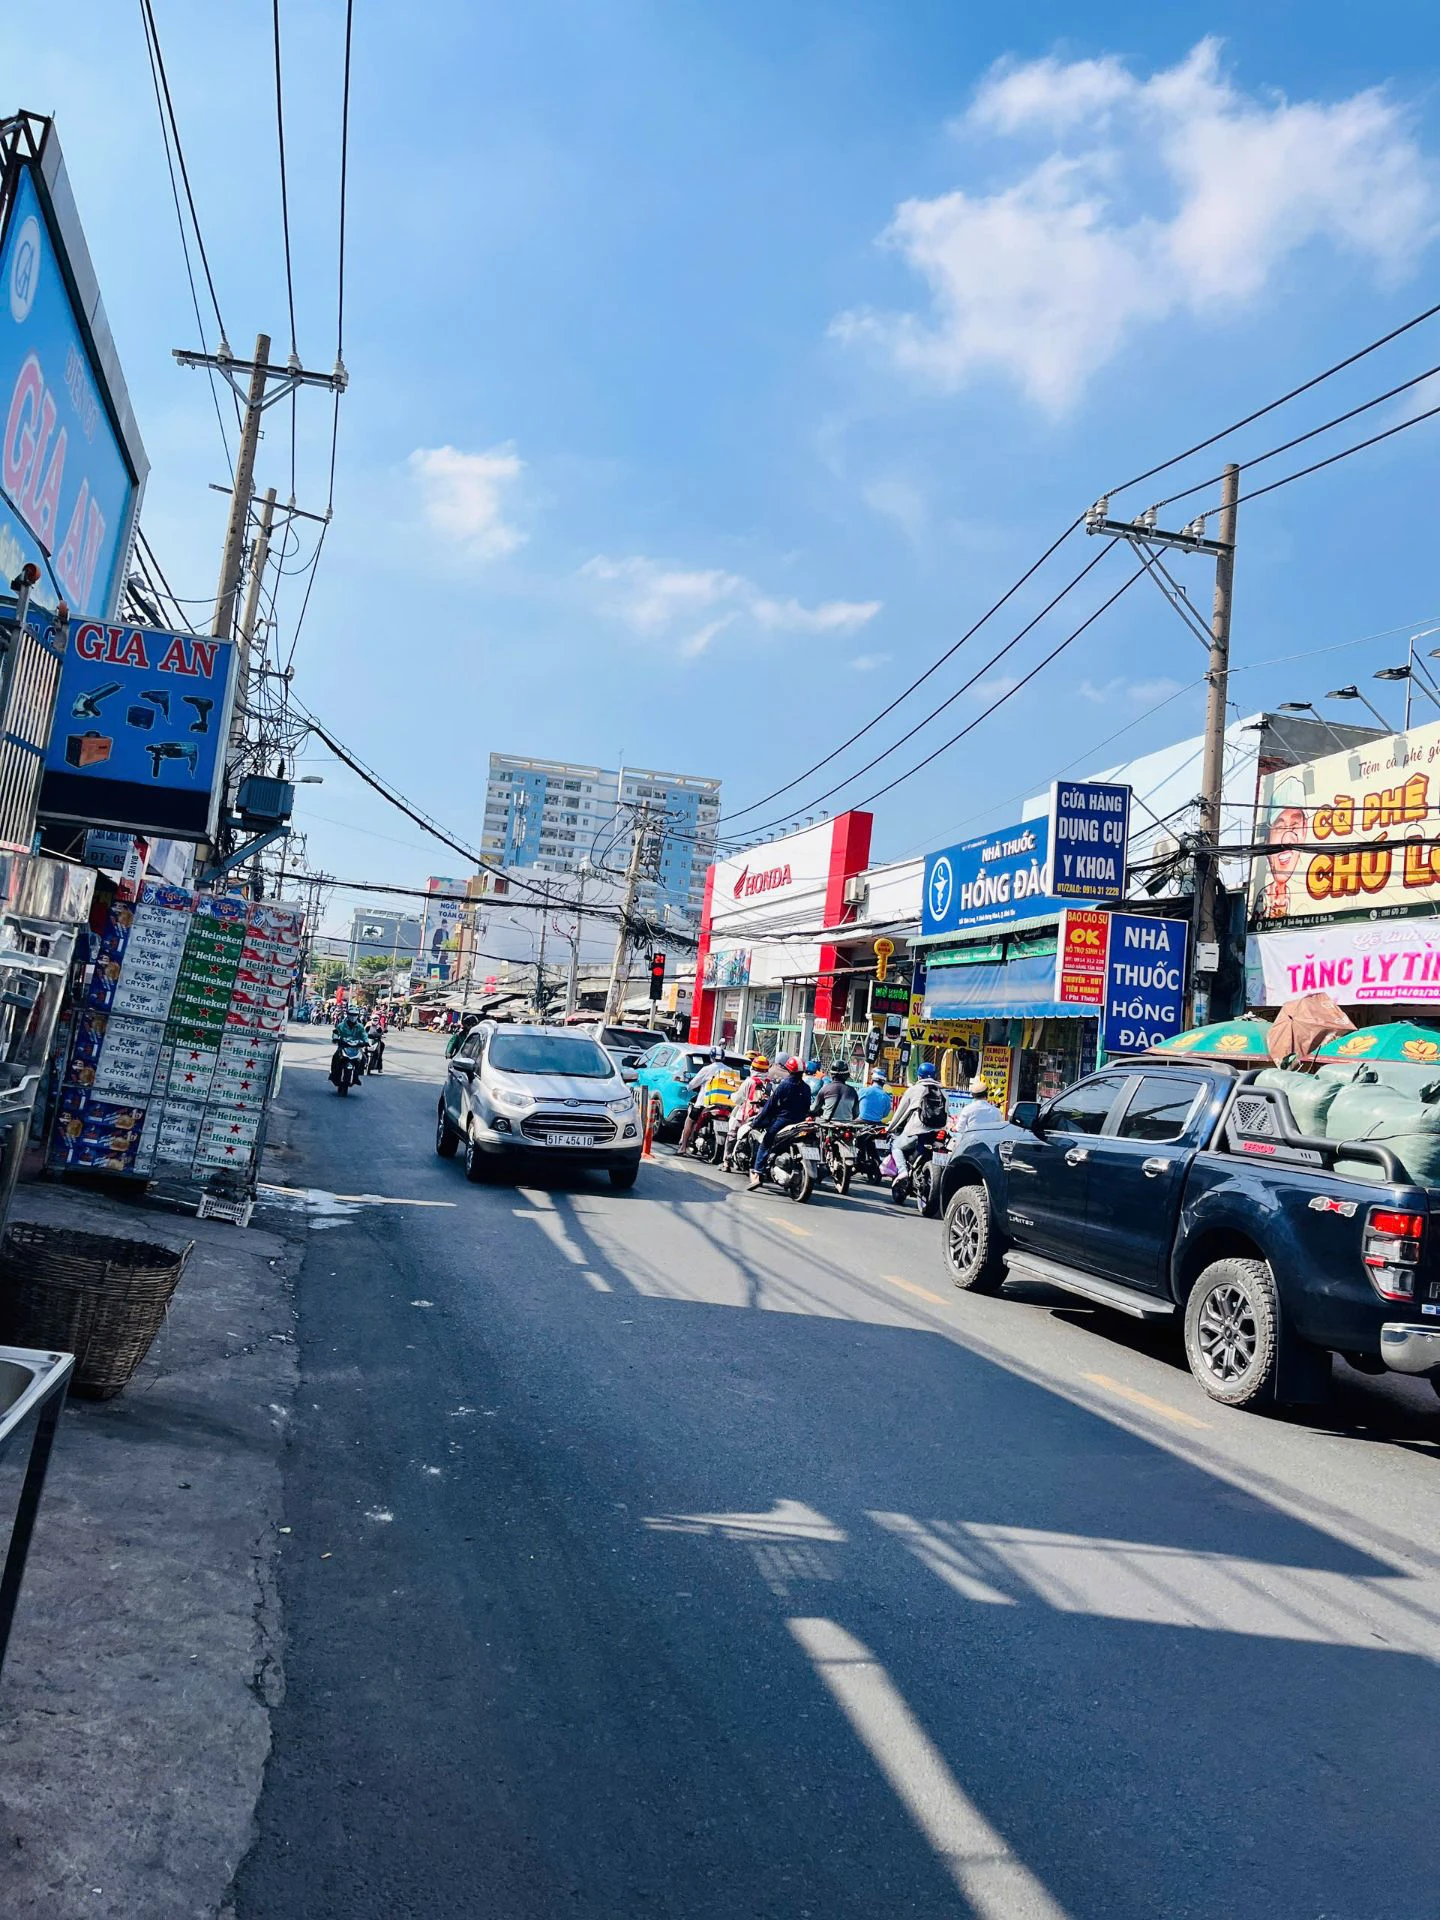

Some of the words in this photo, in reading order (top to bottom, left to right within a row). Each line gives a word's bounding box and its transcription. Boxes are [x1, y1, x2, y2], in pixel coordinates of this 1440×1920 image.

[3, 353, 67, 554] GIA
[56, 477, 106, 614] AN
[75, 623, 150, 669] GIA
[157, 637, 220, 679] AN
[1358, 761, 1380, 779] Tiệm
[1402, 746, 1423, 769] phê
[1061, 787, 1086, 810] CỬA
[1089, 791, 1122, 812] HÀNG
[1362, 772, 1430, 831] PHÊ
[1058, 816, 1099, 845] DỤNG
[1103, 820, 1123, 849] CỤ
[982, 840, 1002, 862] NHÀ
[1002, 829, 1037, 857] THUỐC
[1063, 854, 1073, 877] Y
[1076, 856, 1116, 880] KHOA
[1306, 831, 1392, 901] CHÚ
[745, 864, 792, 896] HONDA
[961, 868, 1011, 911] HỒNG
[142, 913, 176, 925] CRYSTAL
[1067, 911, 1082, 922] BAO
[1082, 912, 1097, 923] CAO
[1097, 914, 1108, 924] SU
[136, 935, 170, 947] CRYSTAL
[201, 929, 242, 945] Heineken
[1070, 928, 1100, 946] OK
[1124, 923, 1170, 952] NHÀ
[250, 938, 293, 953] Heineken
[131, 957, 165, 969] CRYSTAL
[196, 951, 239, 966] Heineken
[245, 960, 287, 975] Heineken
[1362, 952, 1399, 984] LY
[191, 972, 233, 988] Heineken
[1113, 961, 1180, 991] THUỐC
[125, 979, 159, 991] CRYSTAL
[240, 981, 283, 996] Heineken
[120, 1001, 155, 1013] CRYSTAL
[186, 994, 228, 1010] Heineken
[1112, 996, 1175, 1023] HỒNG
[235, 1003, 278, 1017] Heineken
[115, 1022, 150, 1034] CRYSTAL
[181, 1016, 223, 1031] Heineken
[1119, 1027, 1166, 1048] ĐÀO
[109, 1045, 144, 1057] CRYSTAL
[176, 1038, 219, 1053] Heineken
[232, 1047, 273, 1060] Heineken
[104, 1067, 139, 1079] CRYSTAL
[227, 1068, 269, 1082] Heineken
[222, 1090, 264, 1103] Heineken
[156, 1099, 192, 1111] CYSTAL
[217, 1111, 258, 1125] Heineken
[151, 1122, 185, 1133] CYSTAL
[212, 1133, 253, 1147] Heineken
[207, 1154, 246, 1167] Heineke
